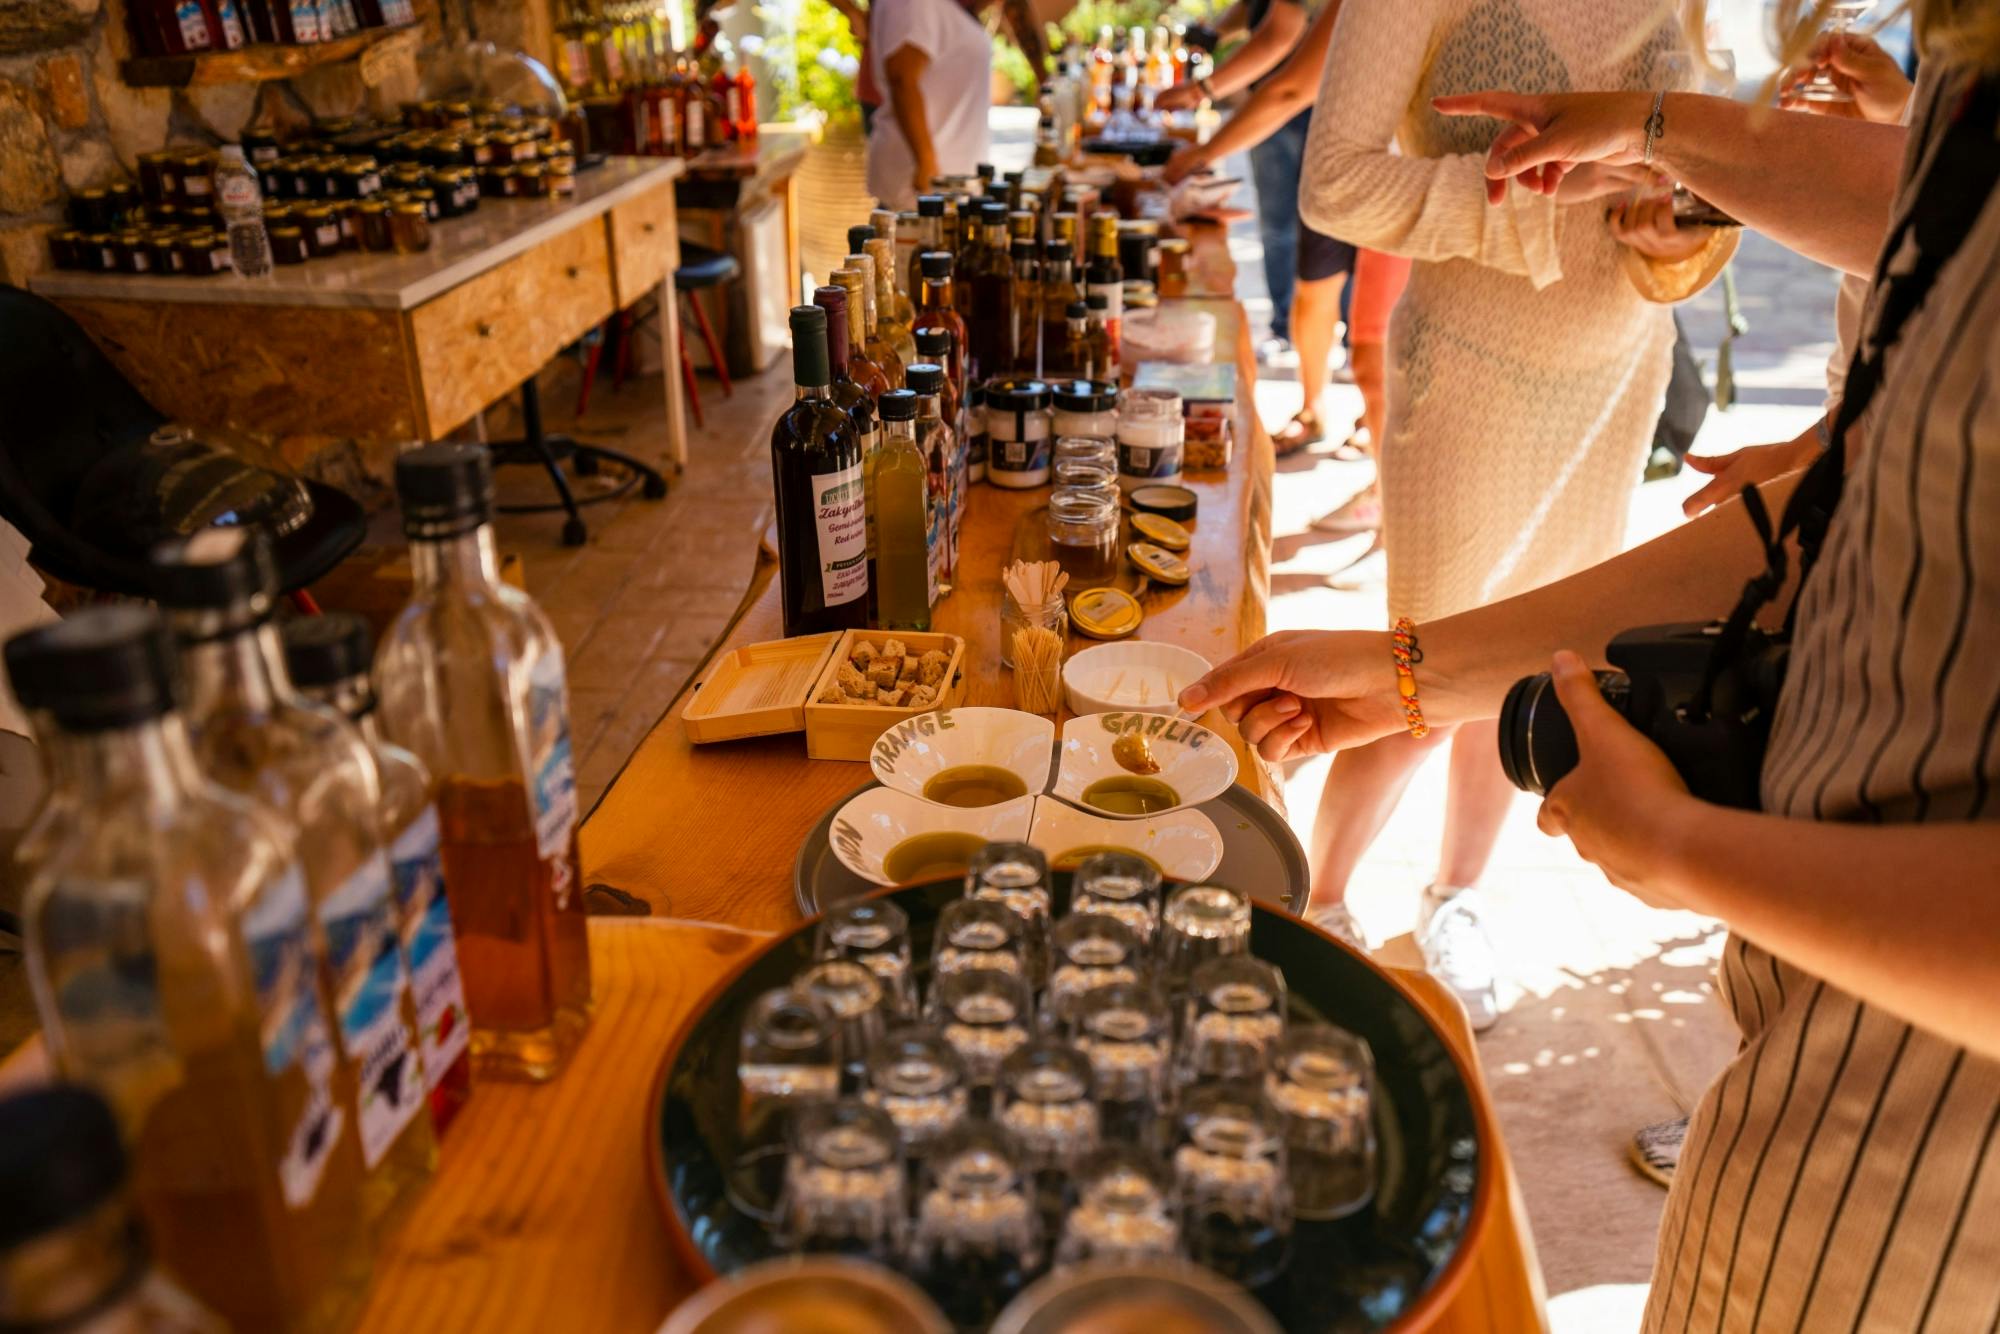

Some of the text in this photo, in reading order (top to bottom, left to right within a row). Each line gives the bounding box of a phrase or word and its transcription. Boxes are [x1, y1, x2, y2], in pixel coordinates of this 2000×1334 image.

[835, 534, 849, 544] Red
[872, 709, 955, 774] ORANGE
[1101, 712, 1209, 749] GARLIC
